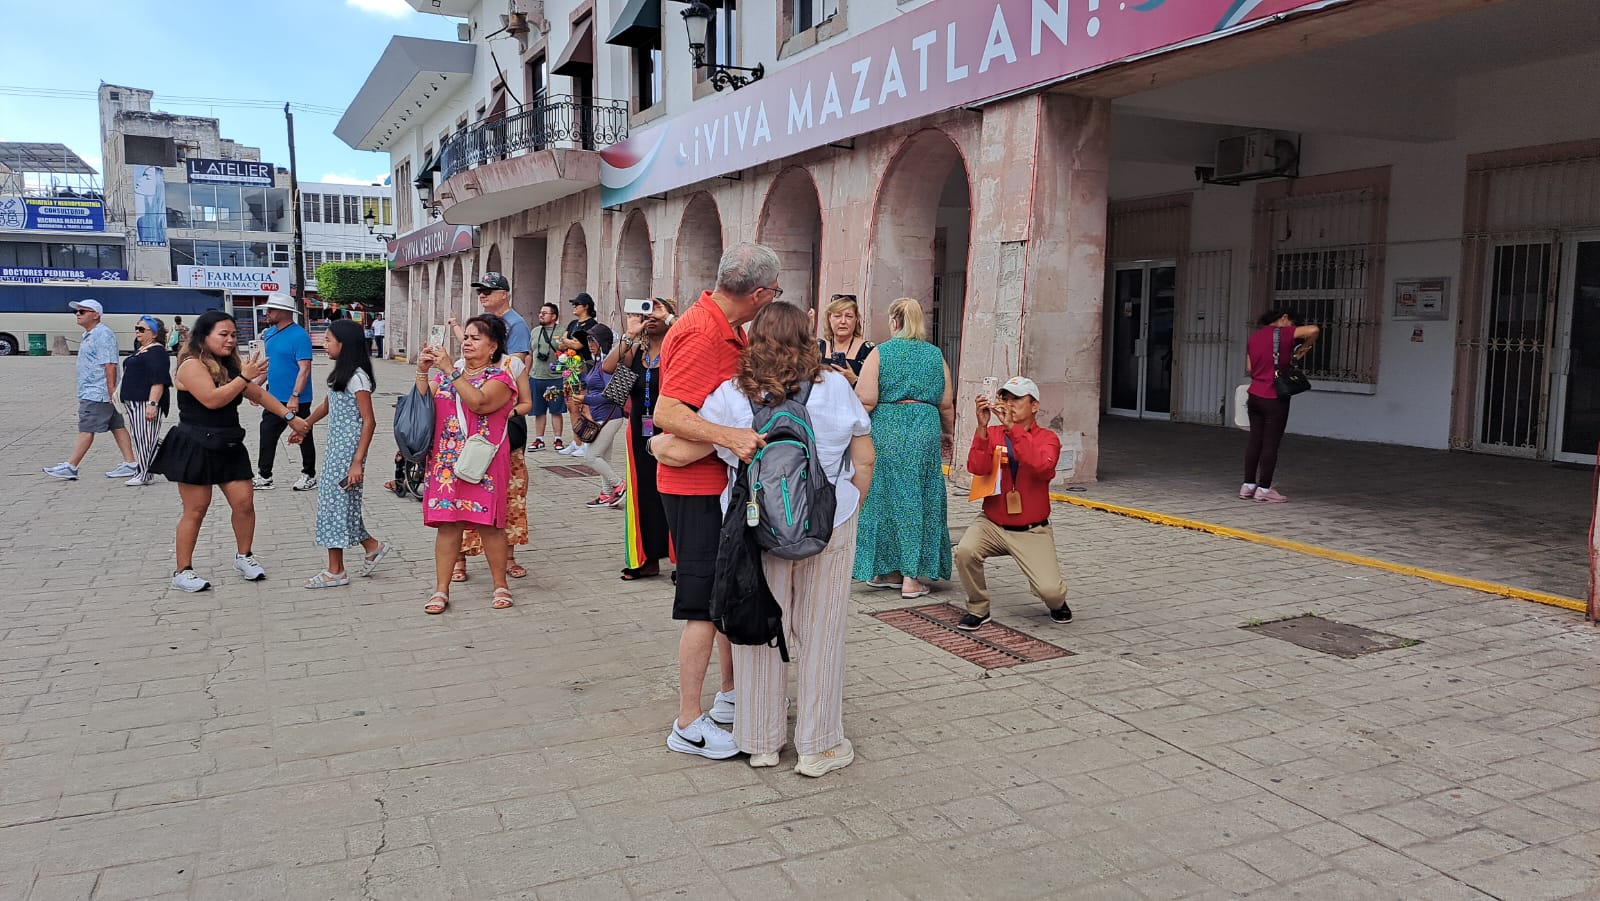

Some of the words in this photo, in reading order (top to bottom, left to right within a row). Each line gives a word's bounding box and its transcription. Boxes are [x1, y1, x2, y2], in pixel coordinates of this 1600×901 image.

[694, 101, 771, 166] ¡VIVA
[3, 268, 43, 277] DOCTORES
[44, 269, 85, 278] PEDIATRAS
[207, 271, 273, 282] FARMACIA
[207, 280, 259, 289] PHARMACY
[261, 283, 279, 291] PVR
